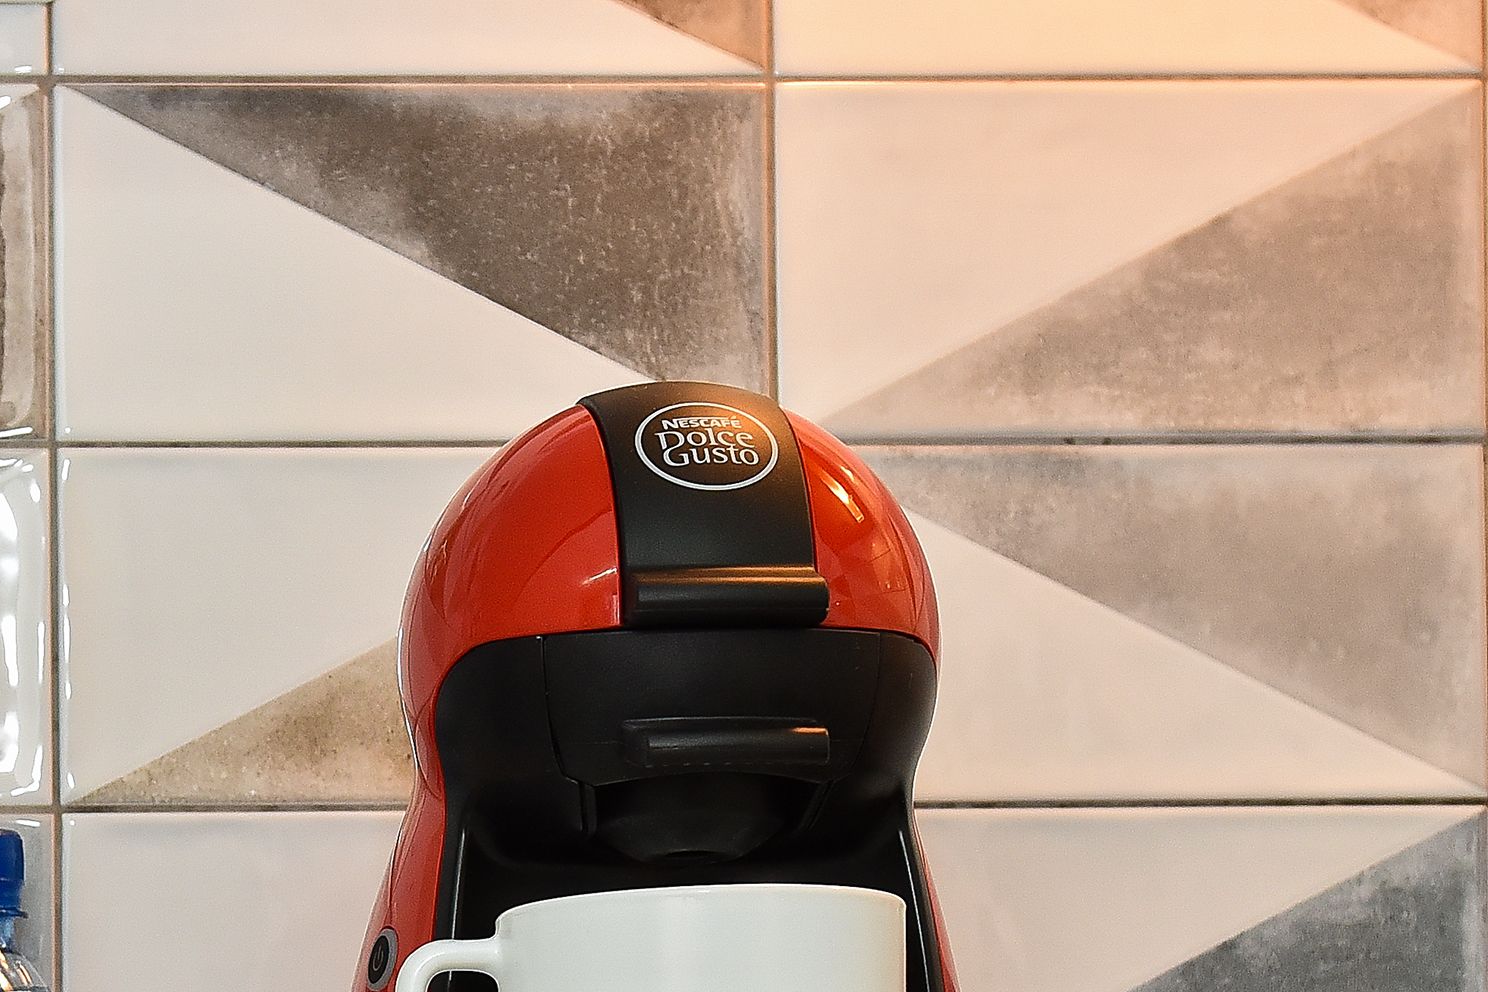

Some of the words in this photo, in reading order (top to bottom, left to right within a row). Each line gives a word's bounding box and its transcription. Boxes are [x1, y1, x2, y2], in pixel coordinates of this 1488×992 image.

[662, 414, 742, 429] NESCAFÉ
[654, 428, 755, 450] Dolce
[663, 444, 760, 467] Gusto
